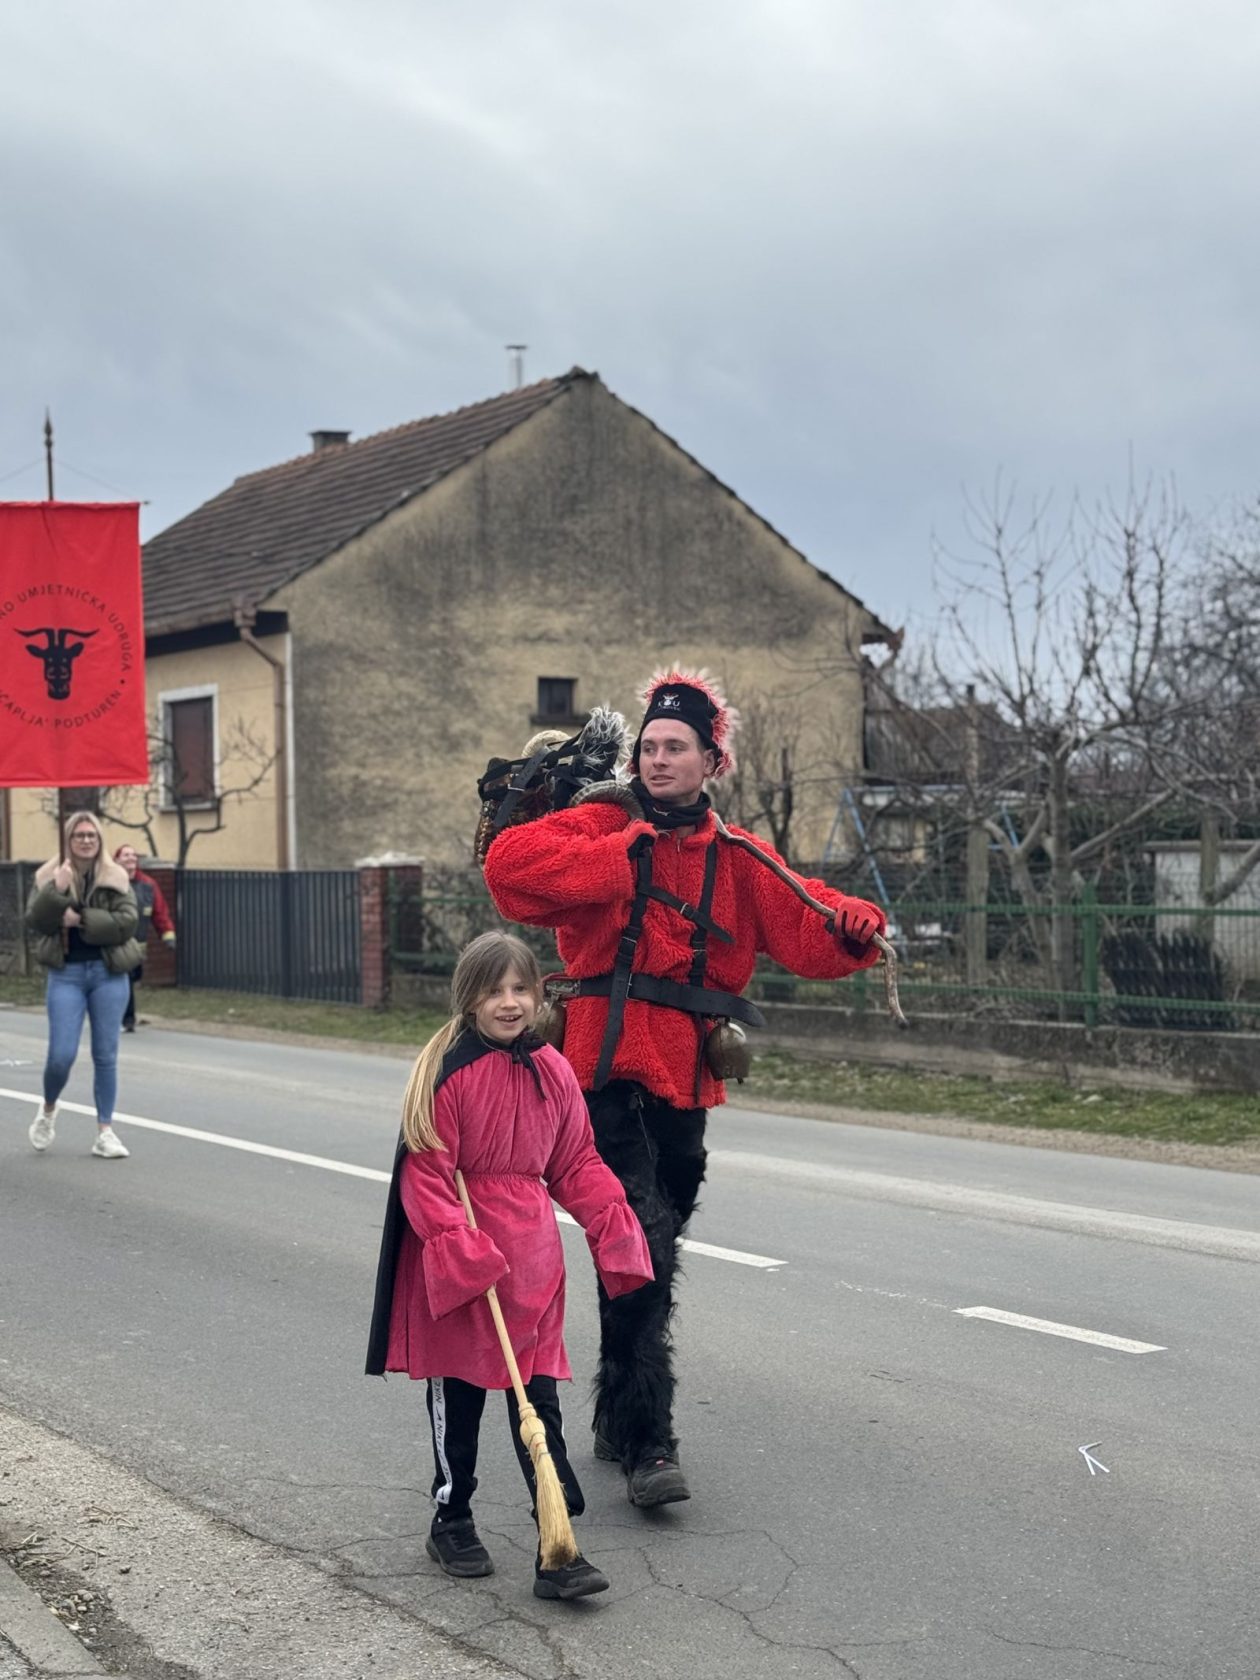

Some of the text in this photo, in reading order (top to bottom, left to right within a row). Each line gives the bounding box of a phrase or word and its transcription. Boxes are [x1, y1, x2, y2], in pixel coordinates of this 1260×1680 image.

[108, 613, 131, 672] UDRUGA
[54, 690, 122, 728] PODTUREN
[434, 1381, 443, 1404] NIKE
